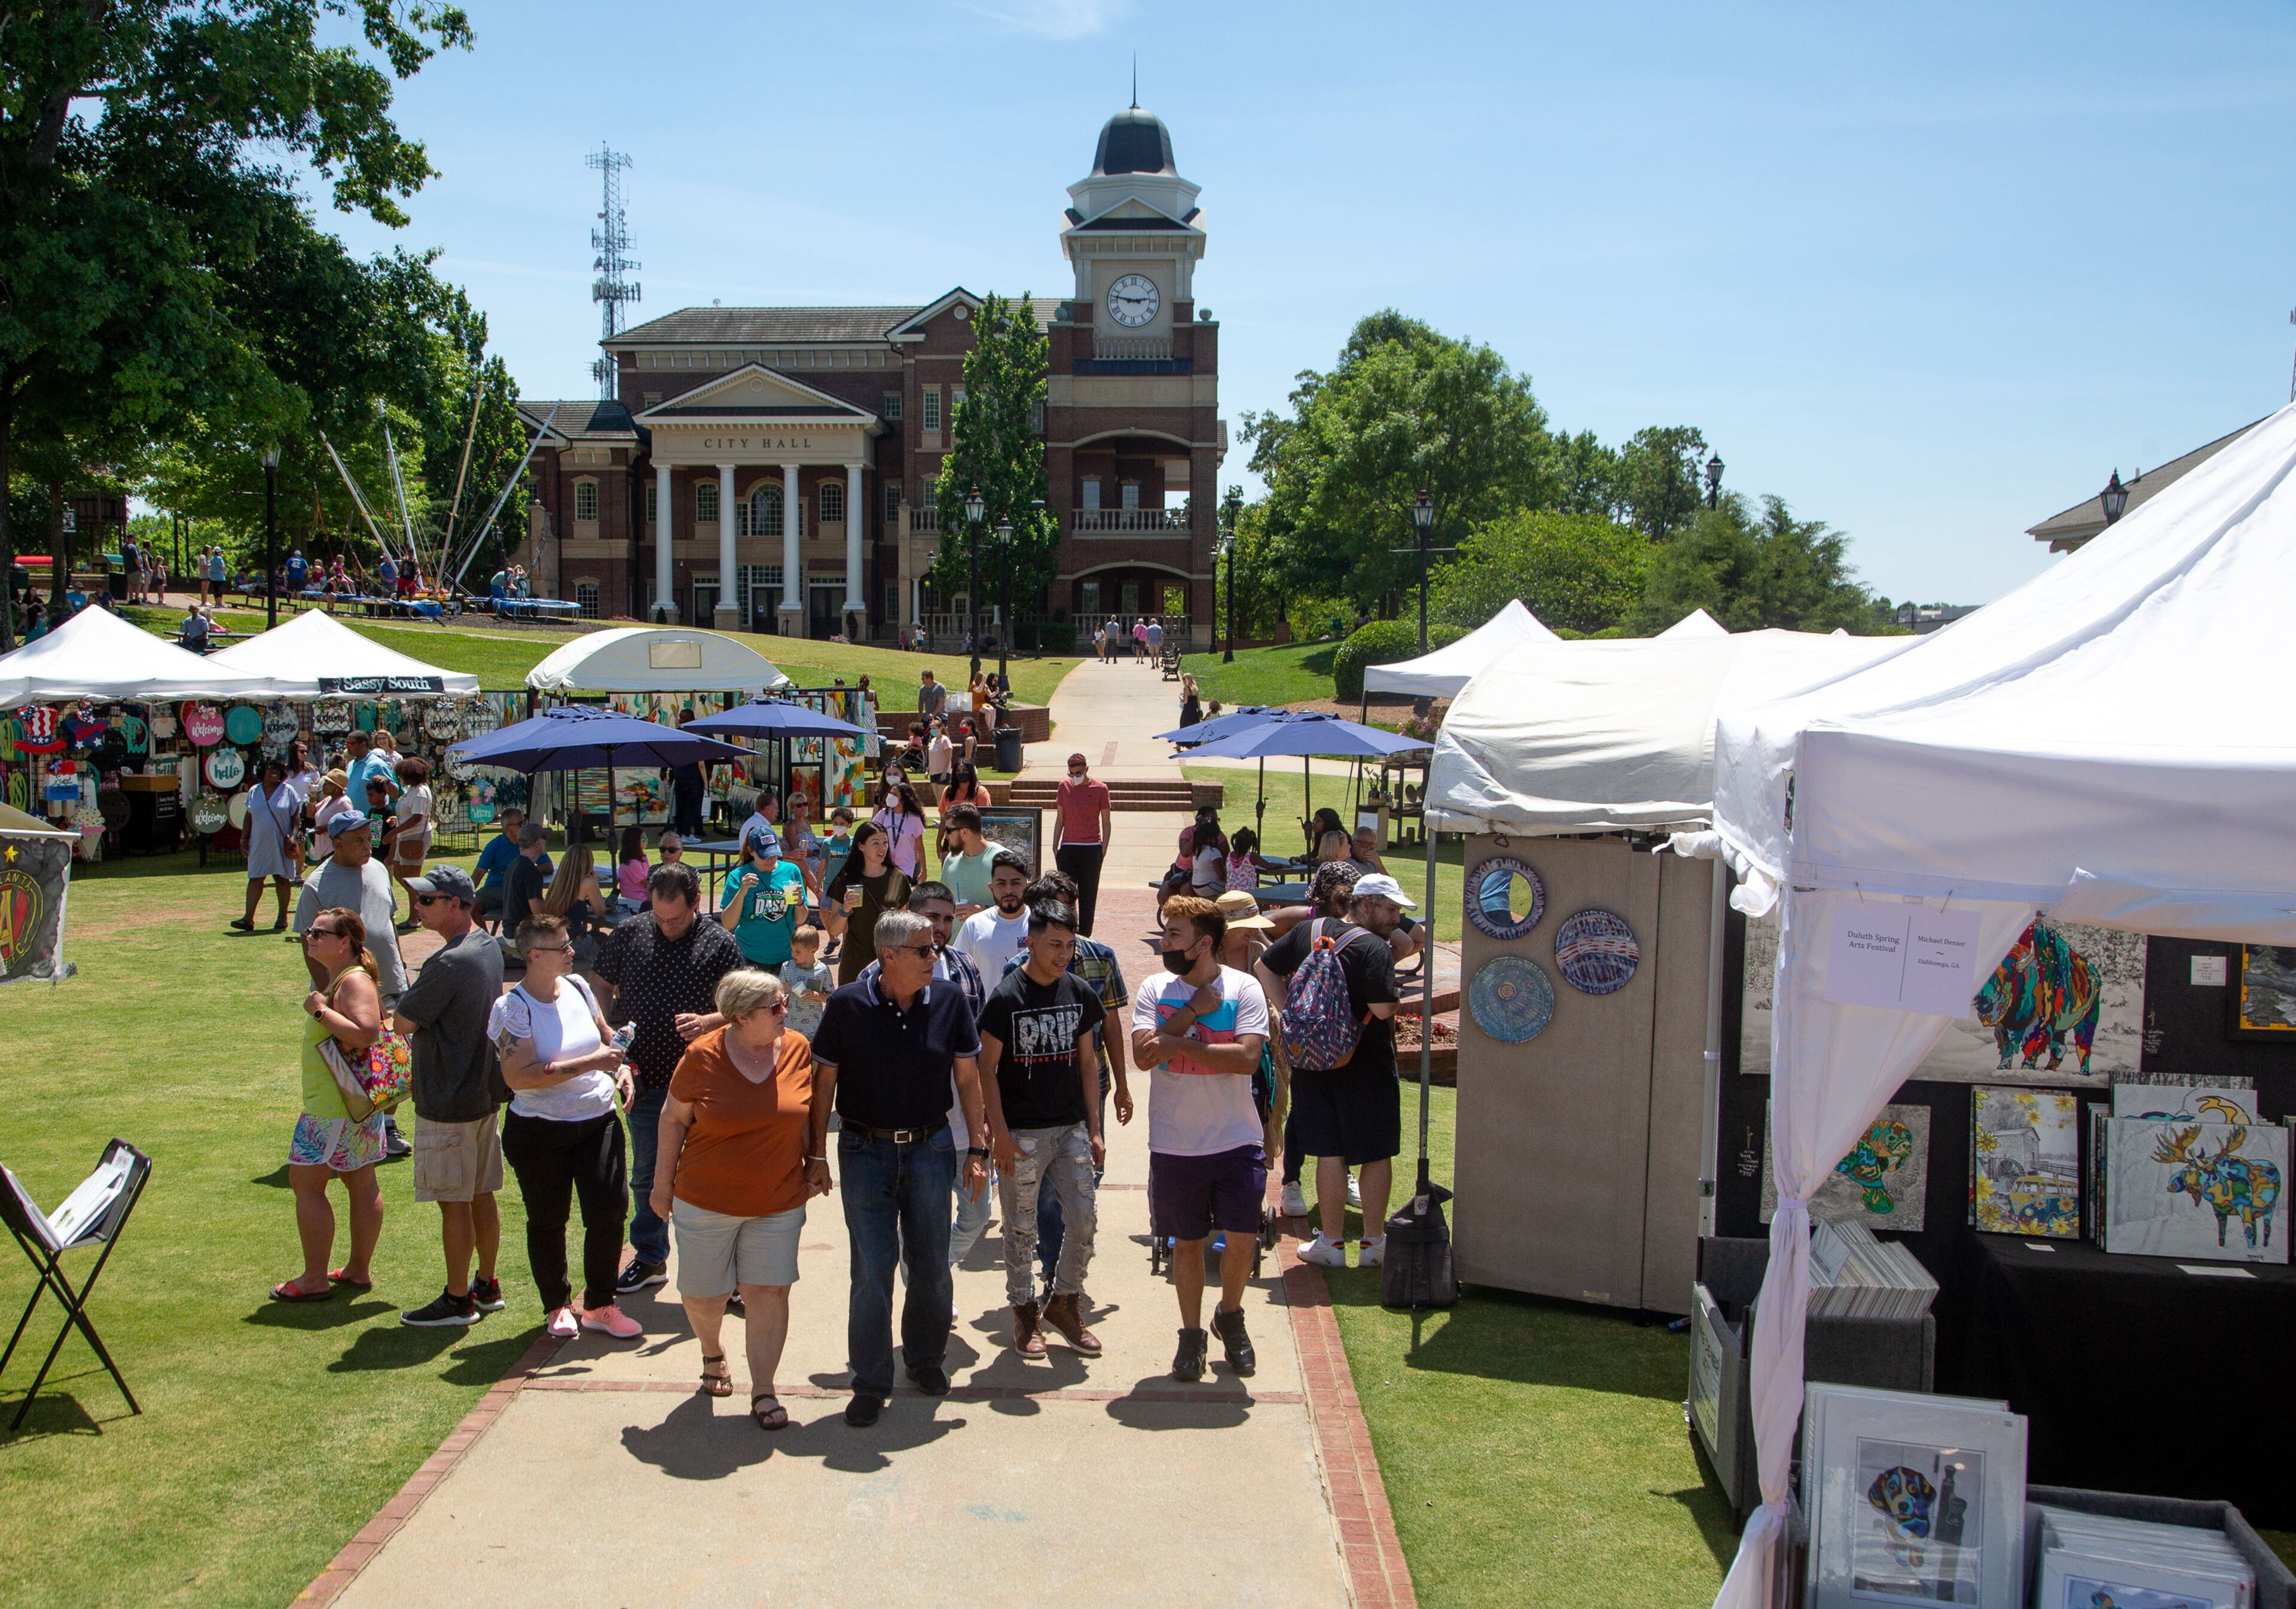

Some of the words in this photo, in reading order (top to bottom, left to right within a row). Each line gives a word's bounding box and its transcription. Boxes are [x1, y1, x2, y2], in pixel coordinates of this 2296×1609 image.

[704, 438, 749, 448] CITY
[762, 438, 811, 448] HALL
[344, 677, 386, 692] Sassy
[388, 676, 431, 690] South
[215, 764, 241, 780] hello
[439, 799, 454, 815] H
[755, 899, 789, 914] DASH
[1848, 930, 1873, 941] Duluth
[1874, 934, 1900, 945] Spring
[1918, 936, 1943, 945] Michael
[1944, 939, 1966, 948] Denier
[1849, 941, 1865, 949] Arts
[1866, 943, 1896, 953] Festival
[1918, 958, 1950, 968] Dahlonega,
[1018, 1010, 1079, 1051] DRIP
